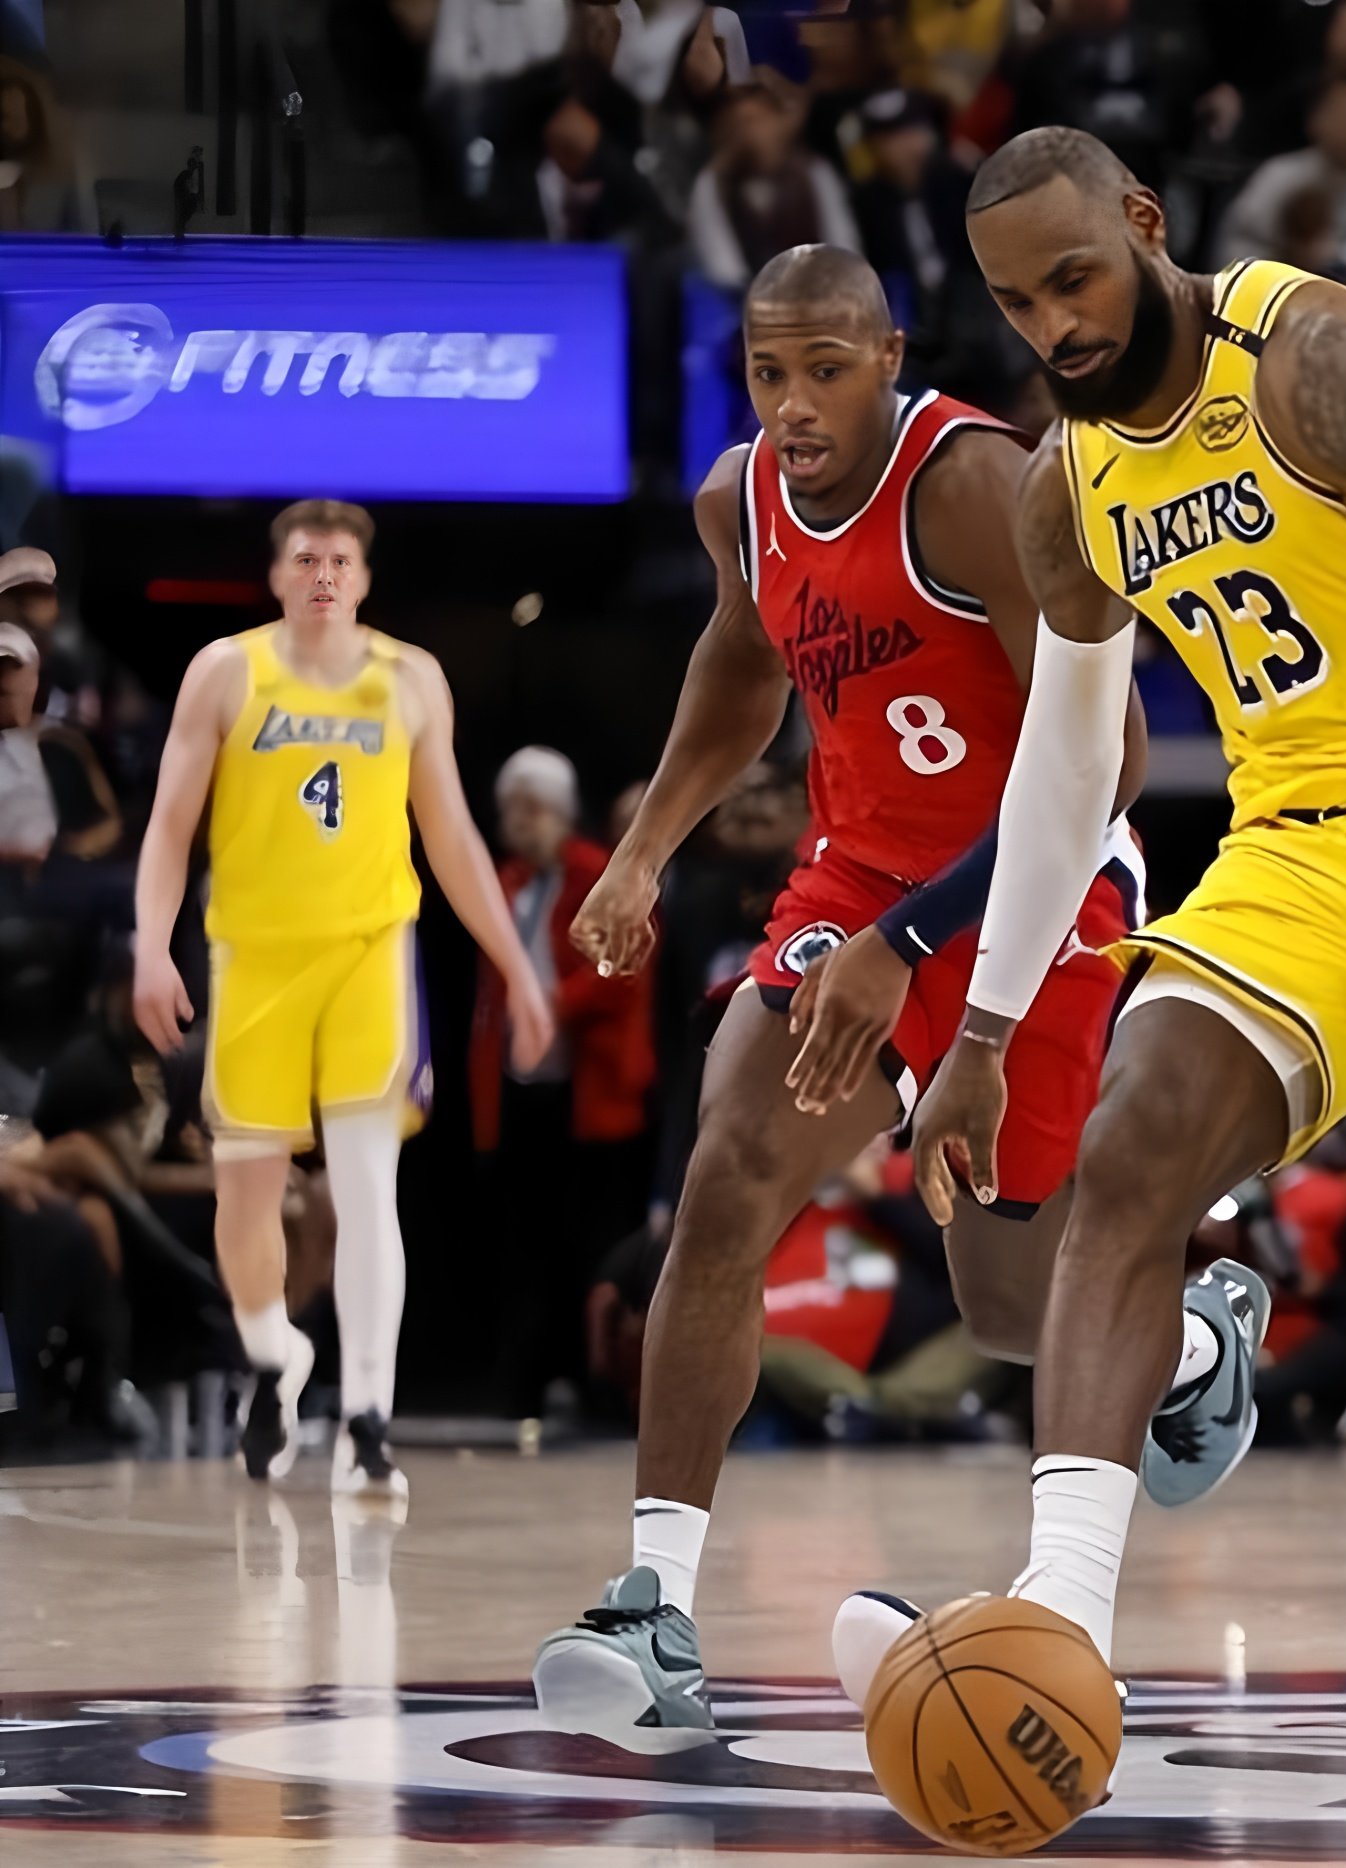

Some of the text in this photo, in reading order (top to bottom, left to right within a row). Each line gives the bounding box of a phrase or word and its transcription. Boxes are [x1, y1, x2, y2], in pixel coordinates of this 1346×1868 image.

[1106, 470, 1277, 596] LAKERS
[1166, 568, 1329, 711] 23
[886, 695, 967, 775] 8
[299, 760, 344, 830] 4
